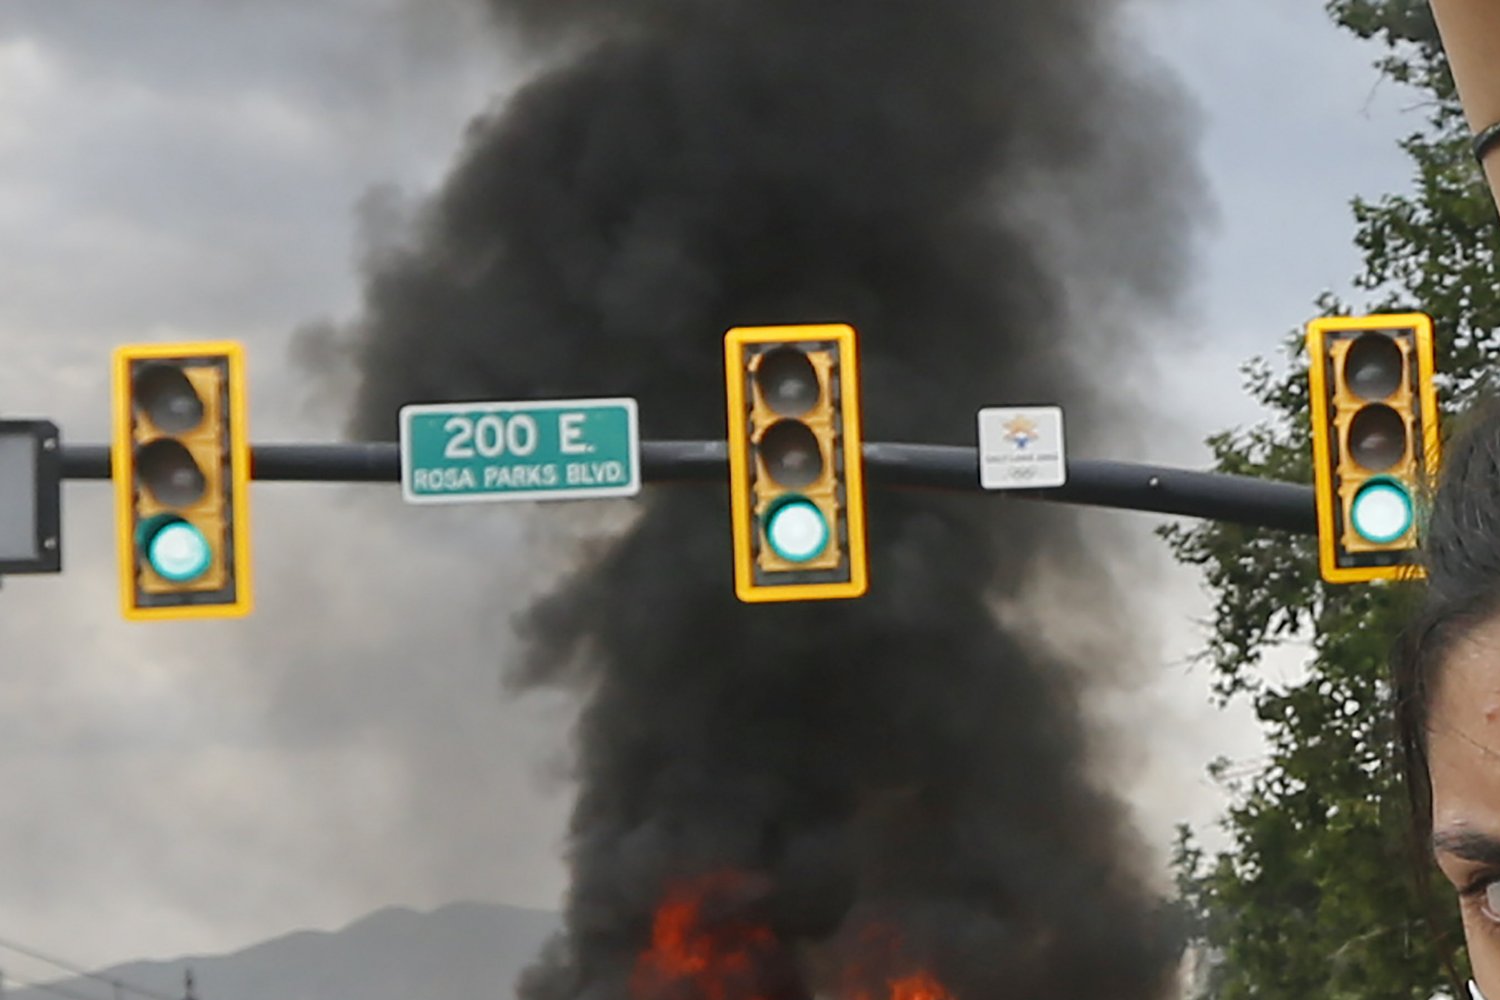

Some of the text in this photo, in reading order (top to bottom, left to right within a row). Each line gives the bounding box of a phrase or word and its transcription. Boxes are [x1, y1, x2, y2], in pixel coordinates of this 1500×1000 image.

[444, 414, 537, 458] 200
[413, 468, 474, 491] ROSA
[484, 464, 558, 488] PARKS
